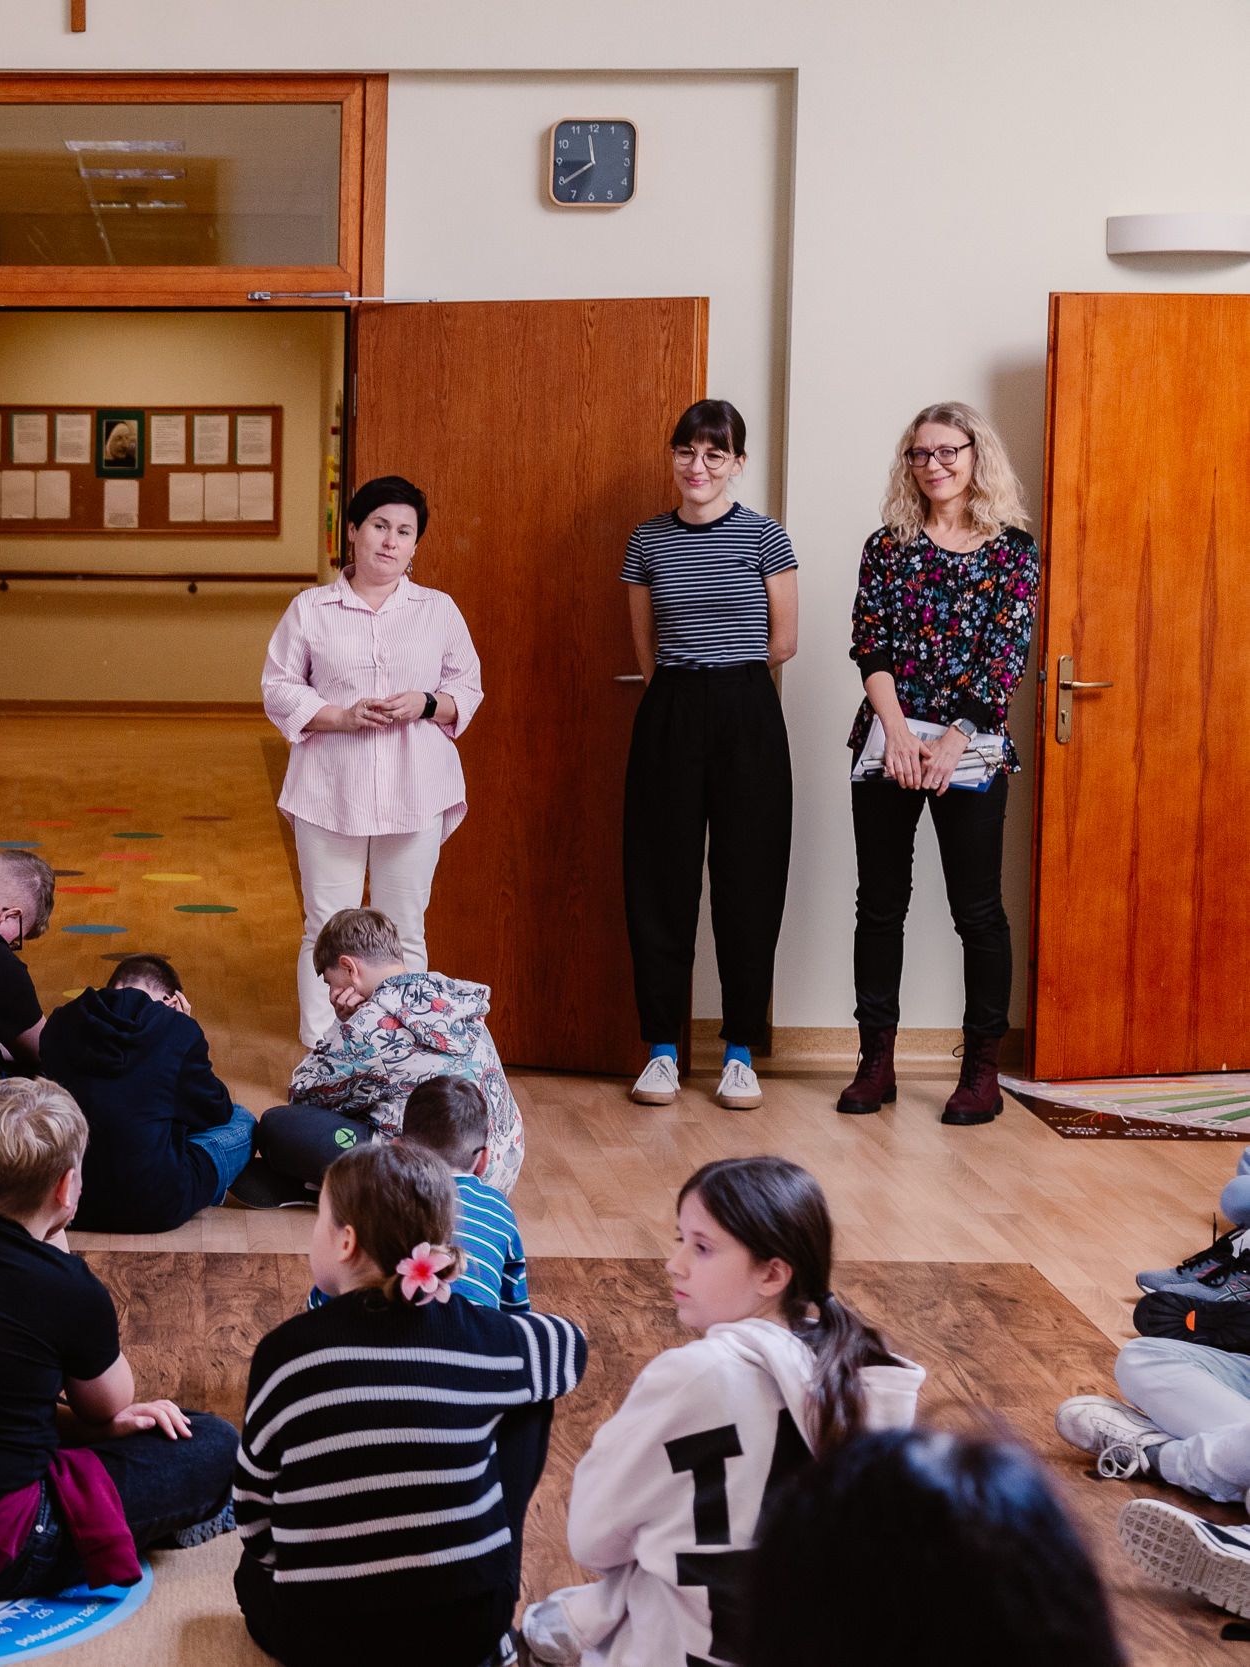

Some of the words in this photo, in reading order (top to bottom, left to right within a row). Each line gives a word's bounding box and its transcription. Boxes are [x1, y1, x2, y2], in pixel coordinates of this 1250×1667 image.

[571, 125, 581, 134] 11
[589, 124, 600, 133] 12
[558, 139, 569, 149] 10
[622, 140, 630, 150] 2
[556, 157, 563, 166] 9
[623, 158, 631, 167] 3
[558, 176, 566, 186] 8
[621, 177, 628, 186] 4
[571, 190, 577, 199] 7
[588, 192, 595, 201] 6
[606, 190, 614, 200] 5
